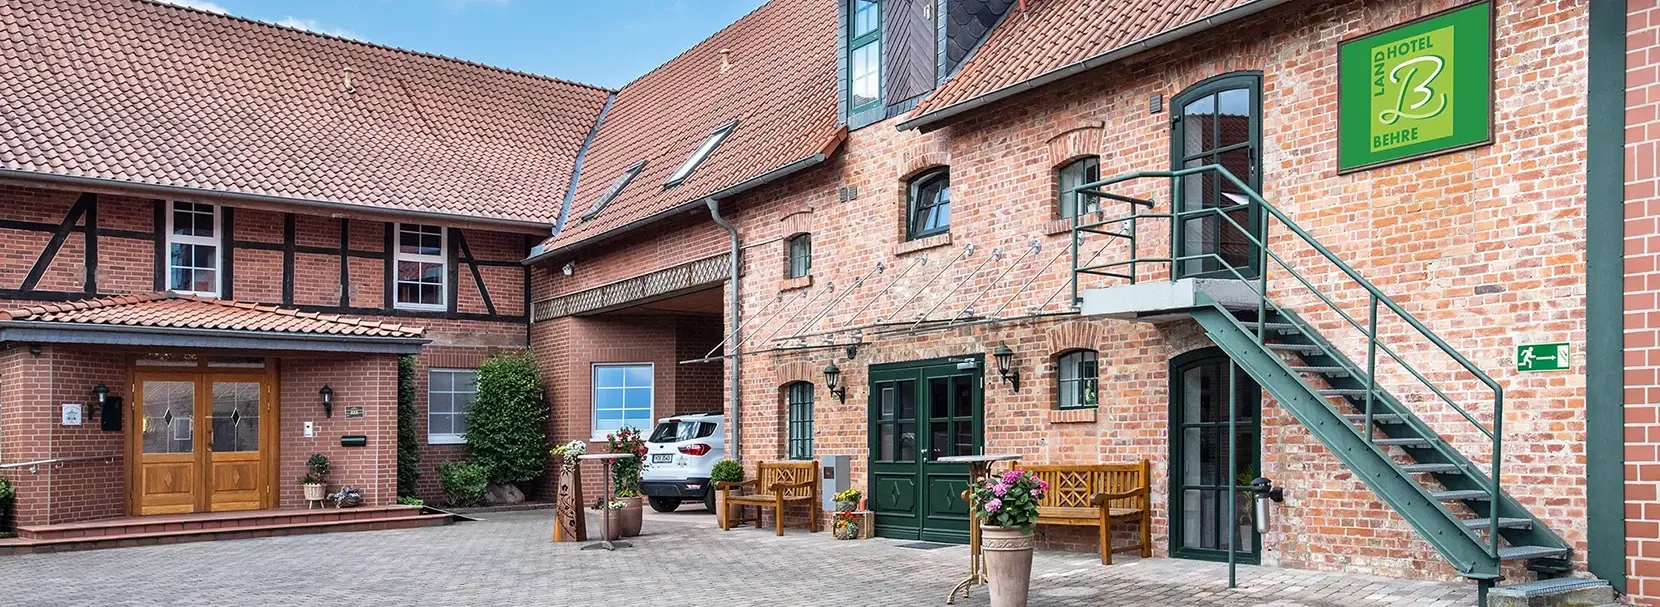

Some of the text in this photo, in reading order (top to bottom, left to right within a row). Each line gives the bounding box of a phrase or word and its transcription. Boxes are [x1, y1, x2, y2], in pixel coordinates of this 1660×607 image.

[1387, 36, 1433, 59] HOTEL
[1374, 51, 1385, 97] LAND
[1373, 127, 1418, 148] BEHRE
